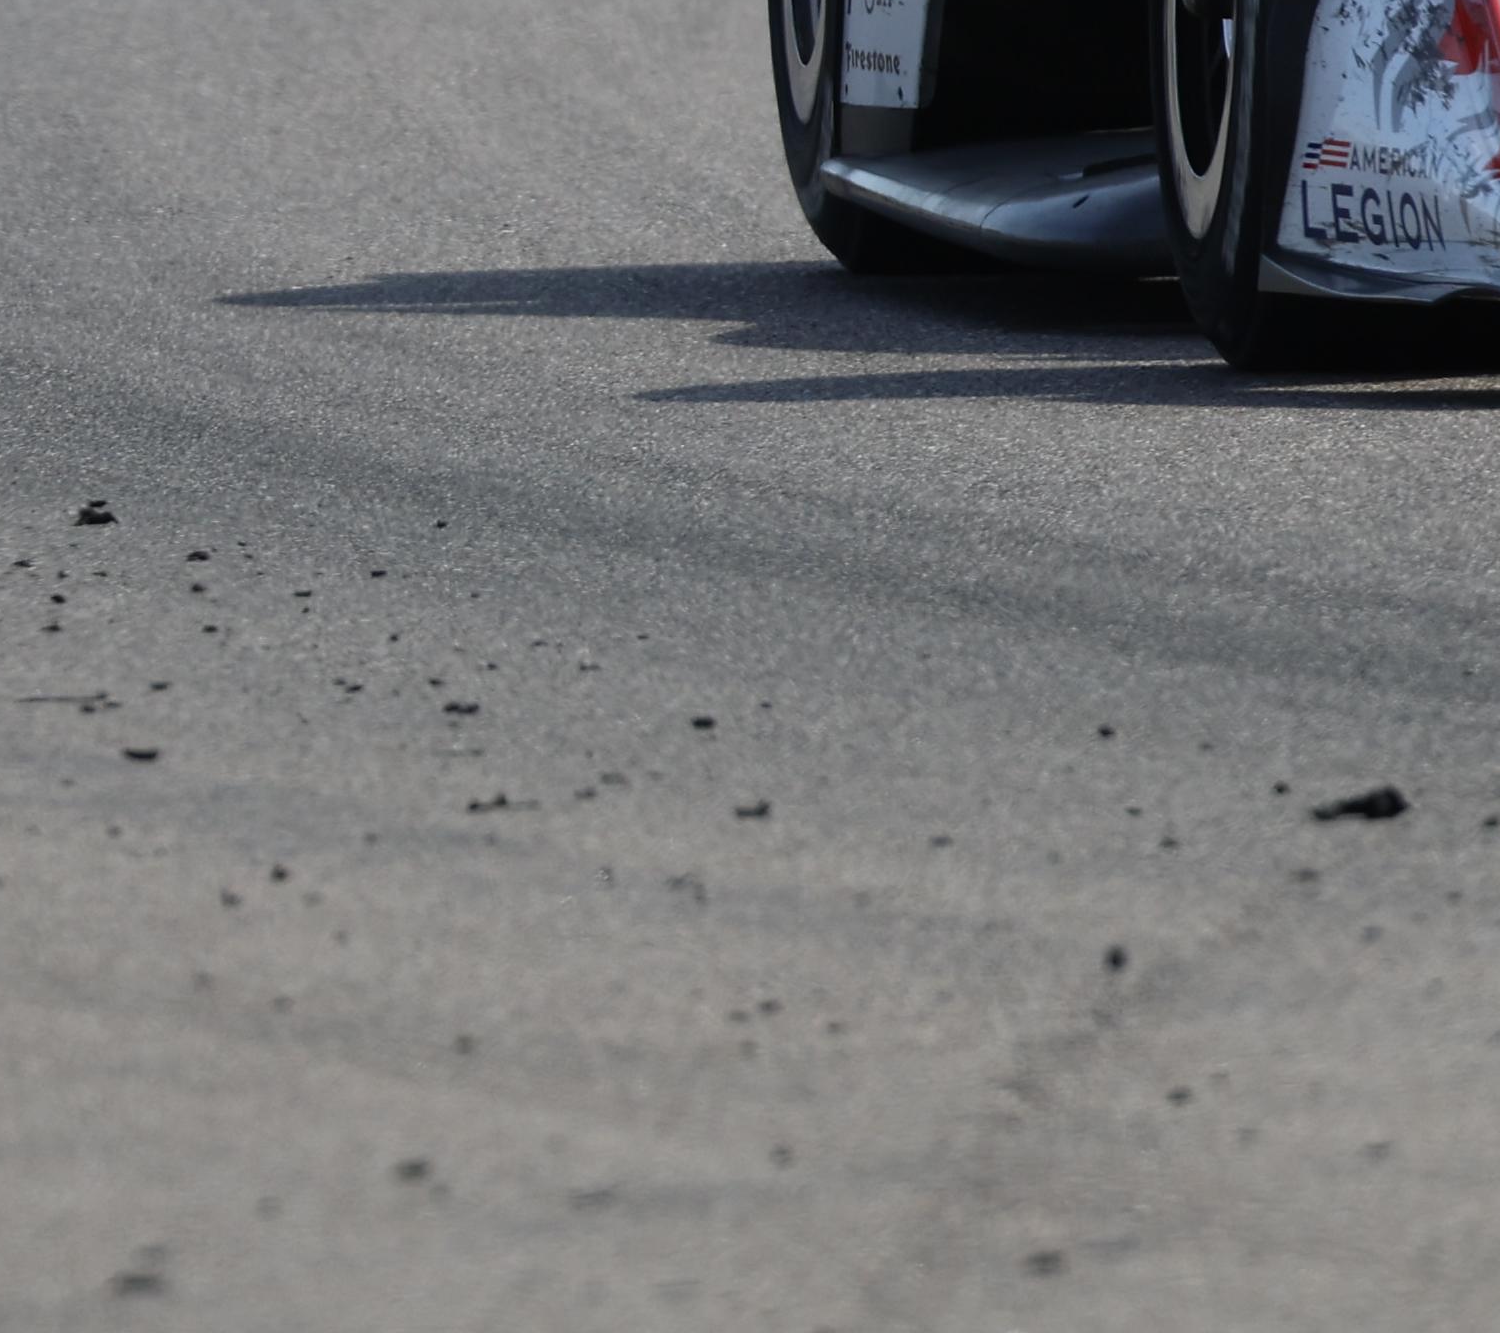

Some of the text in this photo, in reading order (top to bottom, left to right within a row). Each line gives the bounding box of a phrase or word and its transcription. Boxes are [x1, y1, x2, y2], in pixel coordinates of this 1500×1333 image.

[845, 41, 901, 75] Firestone
[1349, 139, 1440, 180] AMERICAN
[1301, 179, 1446, 253] LEGION
